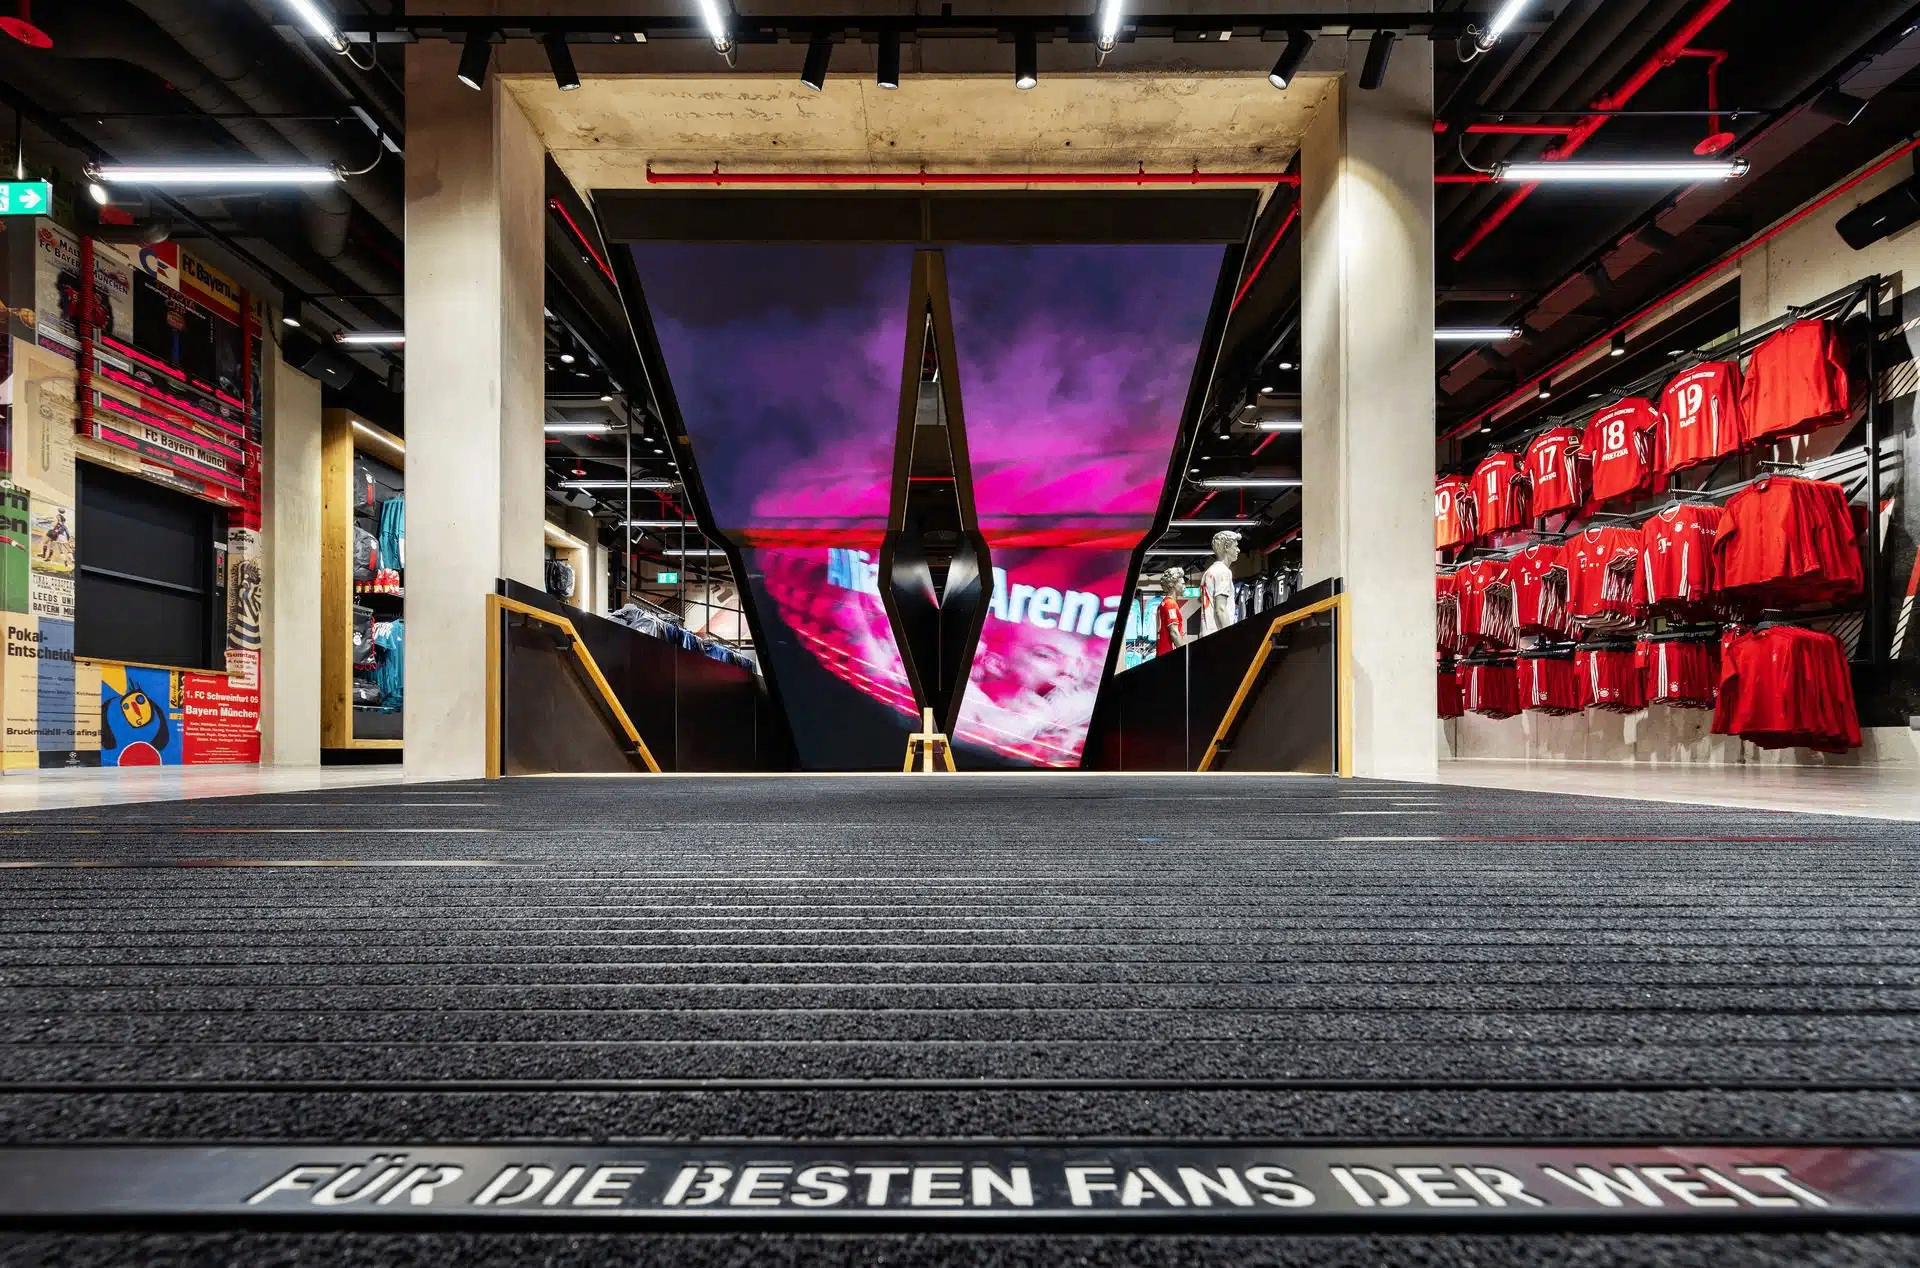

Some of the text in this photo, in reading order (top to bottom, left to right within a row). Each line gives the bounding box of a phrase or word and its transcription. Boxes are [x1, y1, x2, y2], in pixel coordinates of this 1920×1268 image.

[54, 247, 81, 268] BAYER
[182, 253, 195, 276] FC
[1678, 383, 1703, 420] 19
[145, 428, 158, 442] FC
[161, 434, 195, 456] Bayern
[1602, 419, 1625, 454] 18
[1539, 444, 1557, 475] 17
[1486, 469, 1497, 496] 11
[33, 591, 58, 603] LEEDS
[33, 602, 60, 614] BAYERN
[8, 626, 48, 643] Pokal-
[186, 690, 259, 703] 1. FC Schweinfurt 05
[185, 705, 258, 718] Bayern München
[244, 1153, 1830, 1207] FÜR DIE BESTEN FANS DER WELT
